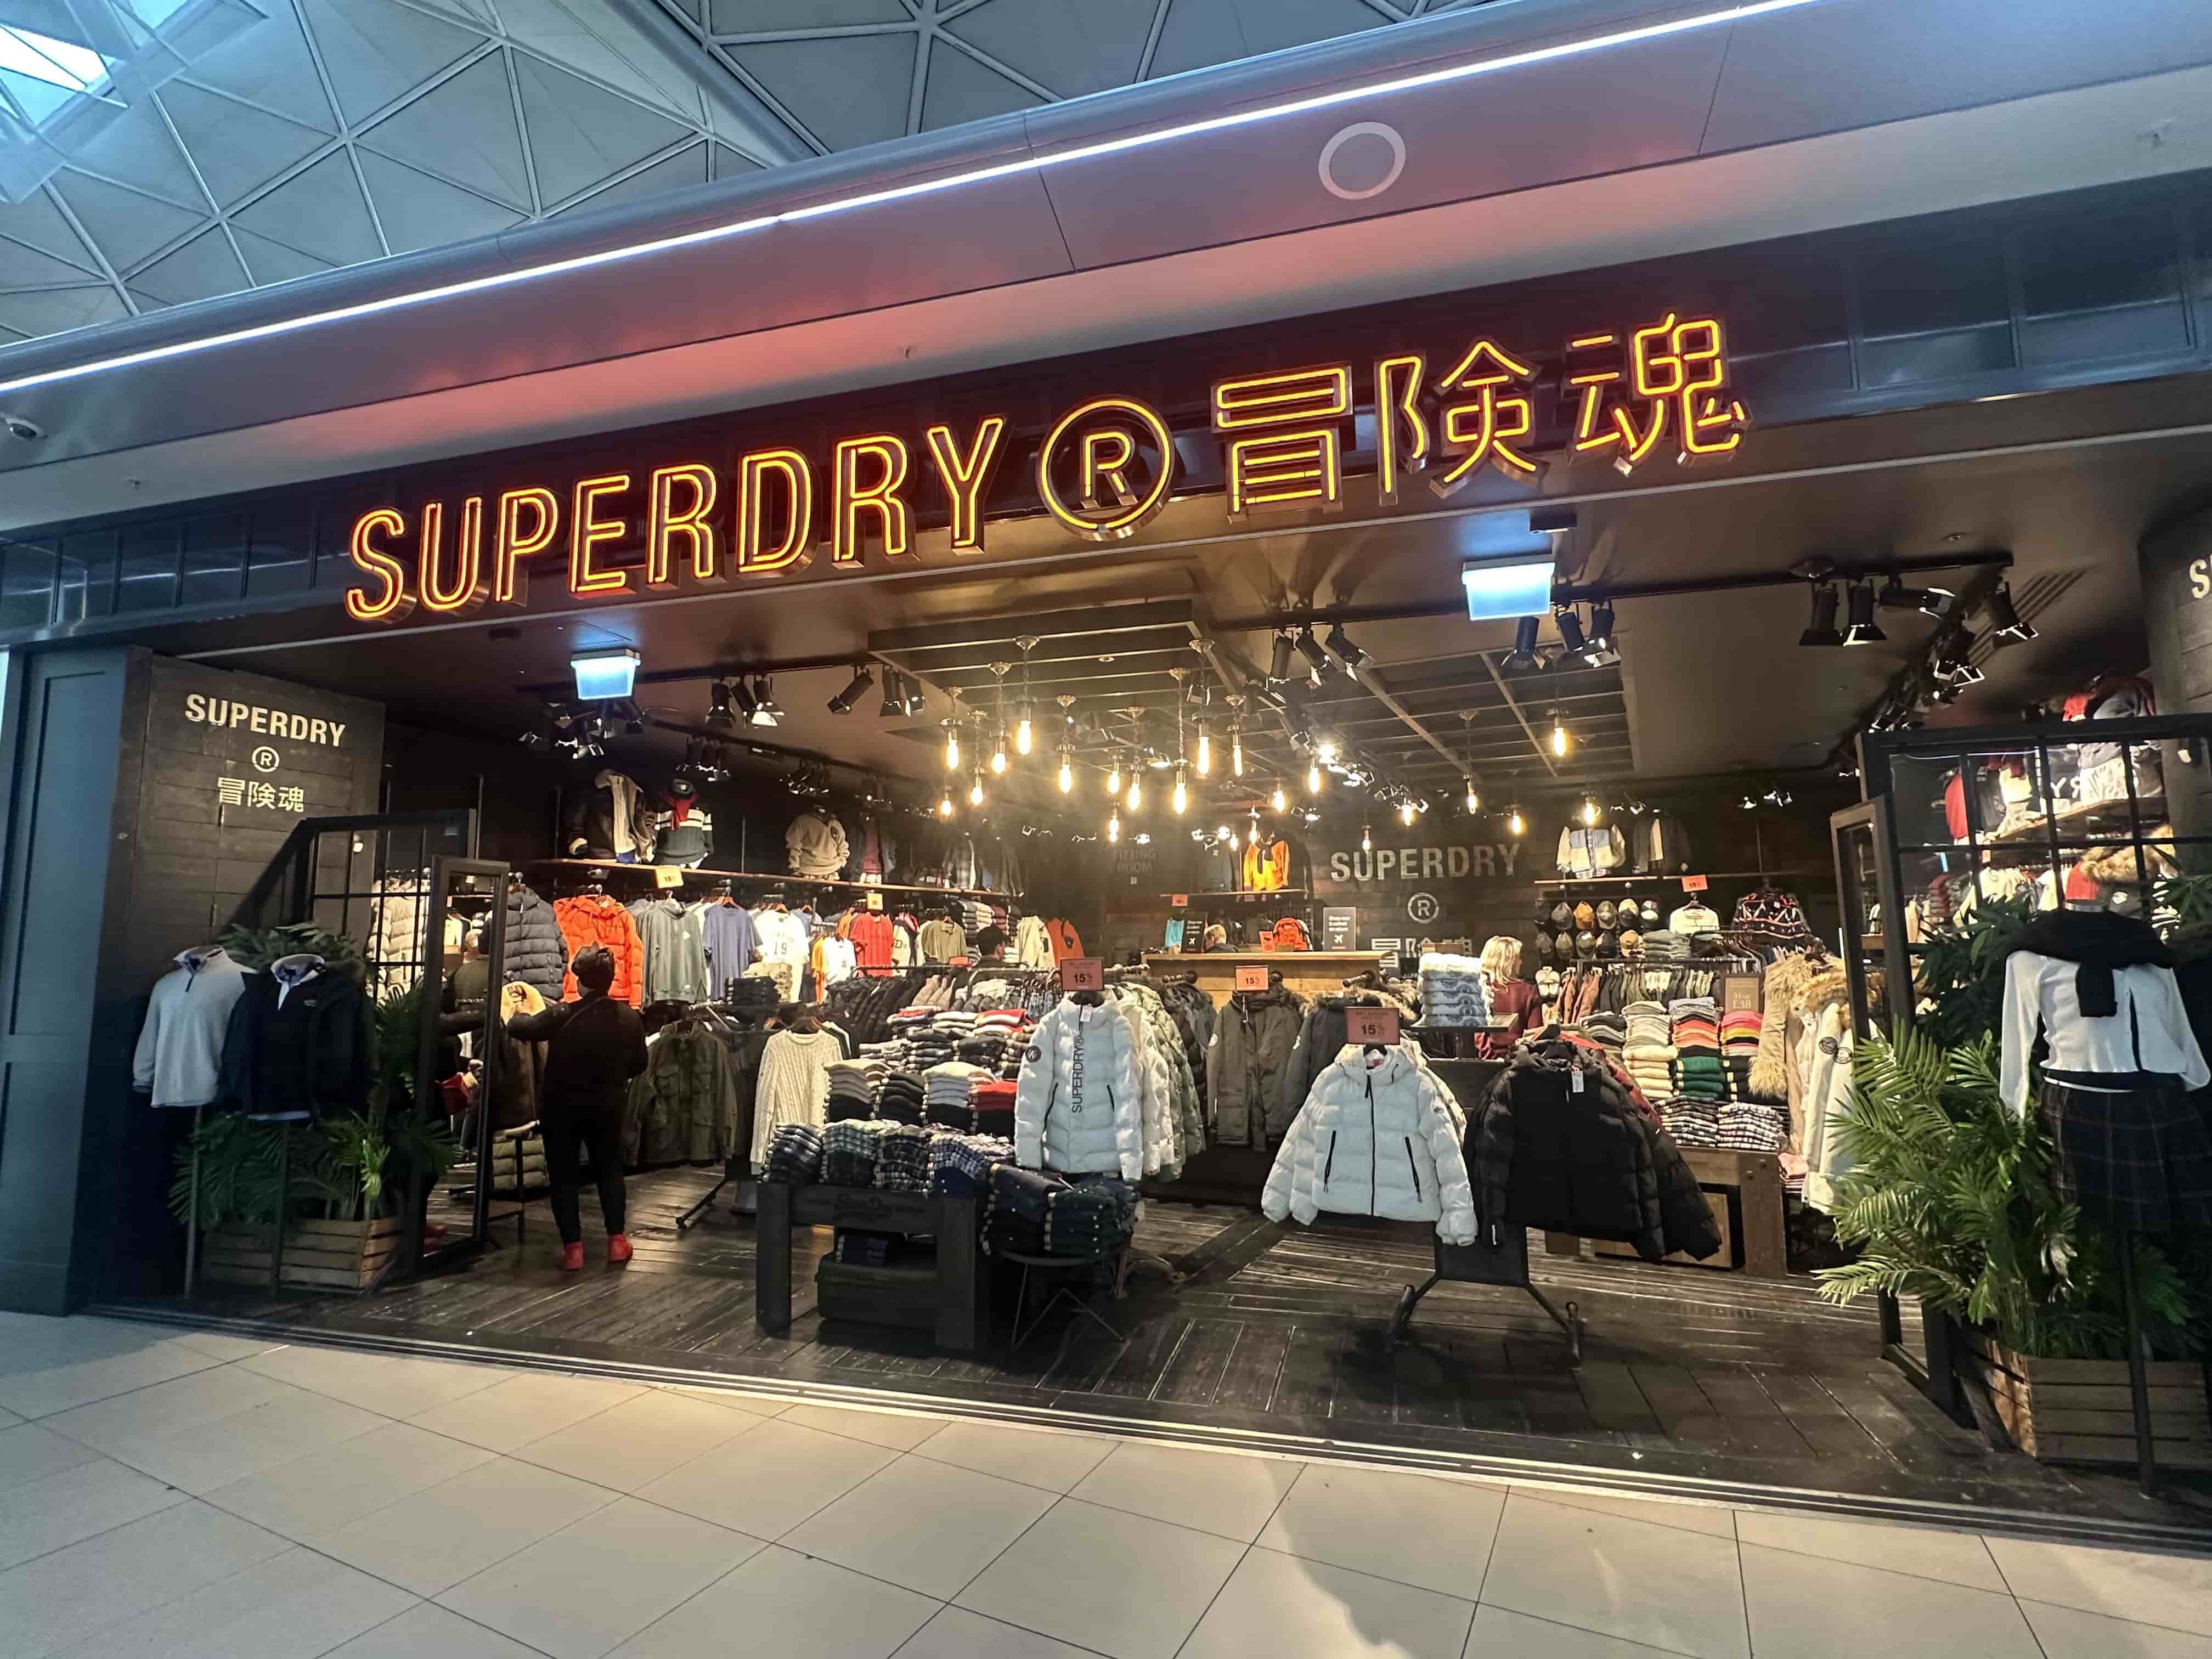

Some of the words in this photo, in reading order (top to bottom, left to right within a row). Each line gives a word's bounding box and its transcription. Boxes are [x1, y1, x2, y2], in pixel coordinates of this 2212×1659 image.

[347, 415, 1008, 622] SUPERDRY
[1212, 313, 1750, 520] 冒険魂
[2189, 554, 2211, 599] S
[185, 693, 346, 747] SUPERDRY
[217, 777, 304, 812] 冒険魂
[1330, 843, 1520, 882] SUPERDRY
